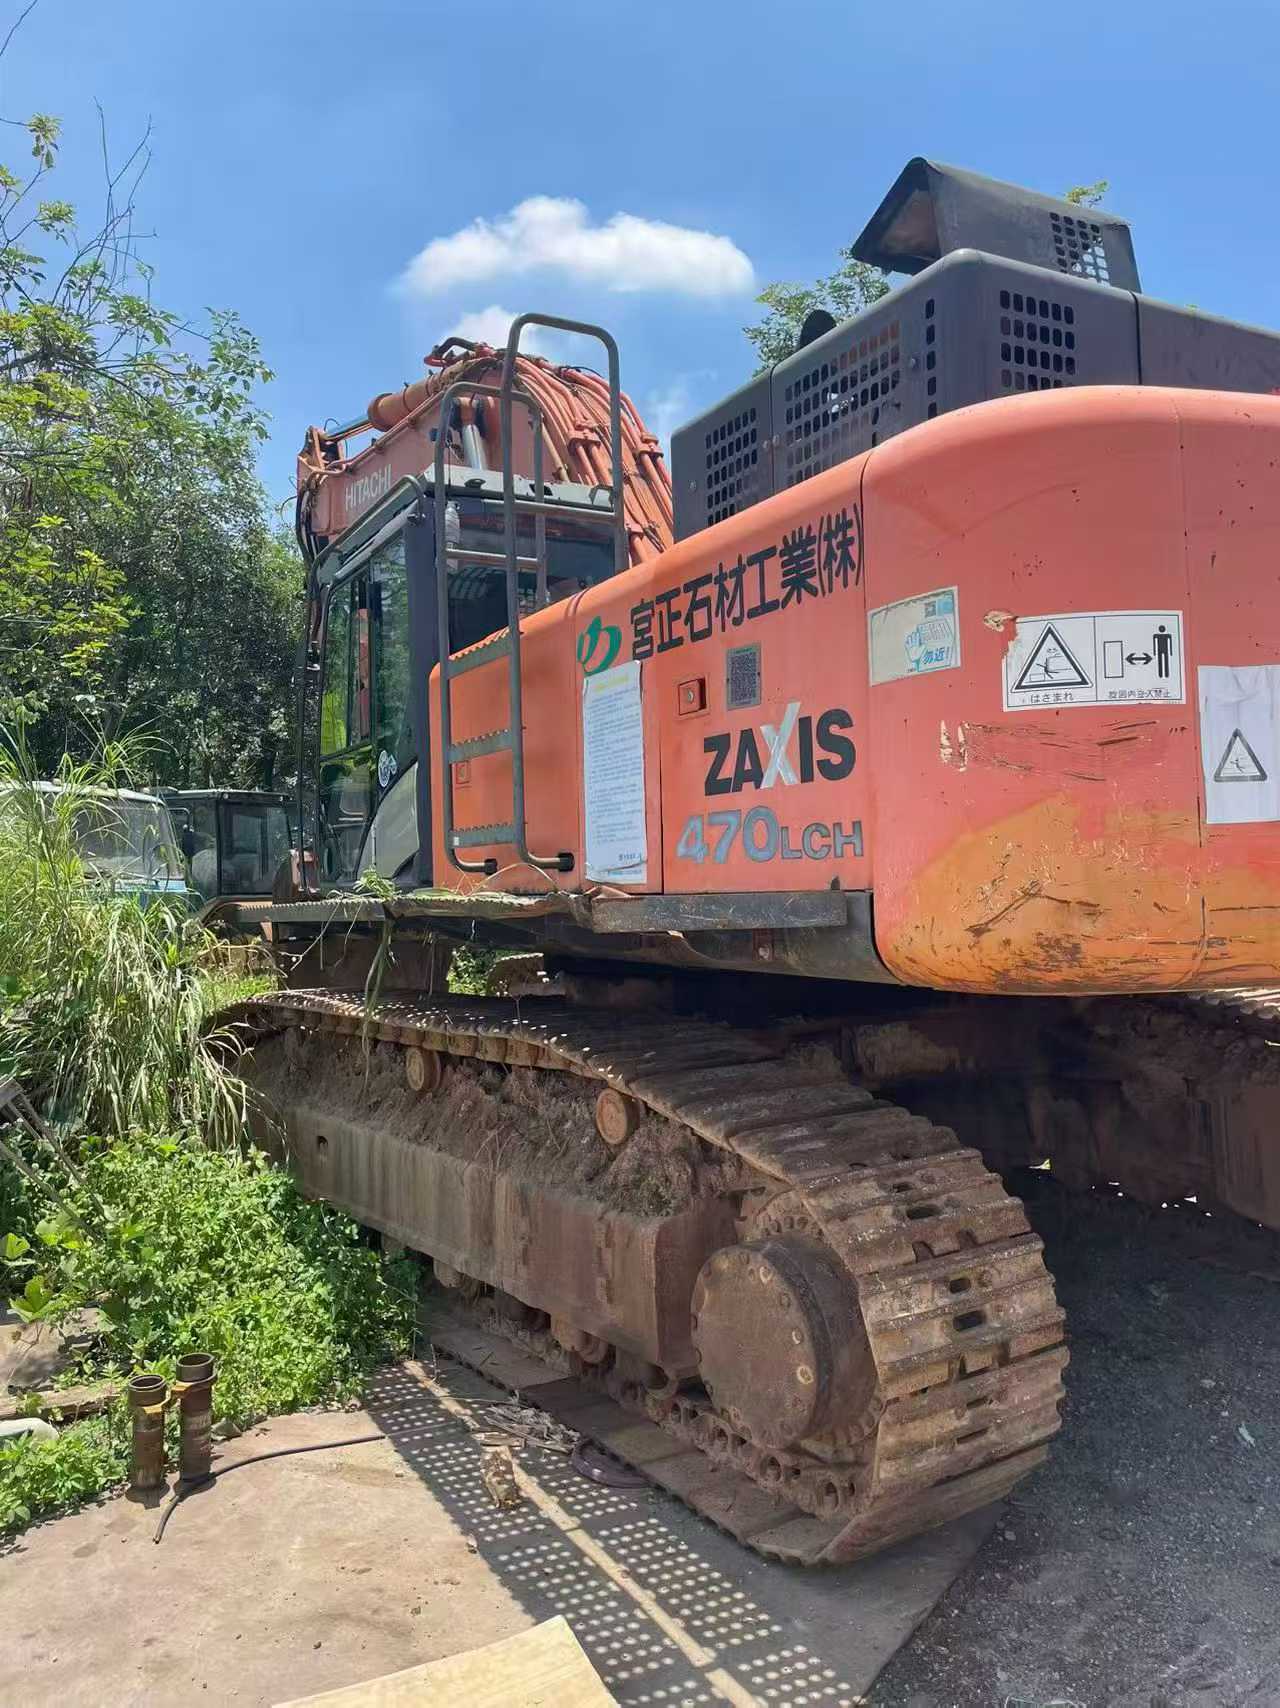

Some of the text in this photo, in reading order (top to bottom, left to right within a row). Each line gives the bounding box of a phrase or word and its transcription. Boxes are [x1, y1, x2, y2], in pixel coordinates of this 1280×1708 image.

[345, 464, 392, 512] HITACHI
[630, 502, 862, 661] 宮正石材工業(株)
[703, 701, 857, 796] ZAXIS
